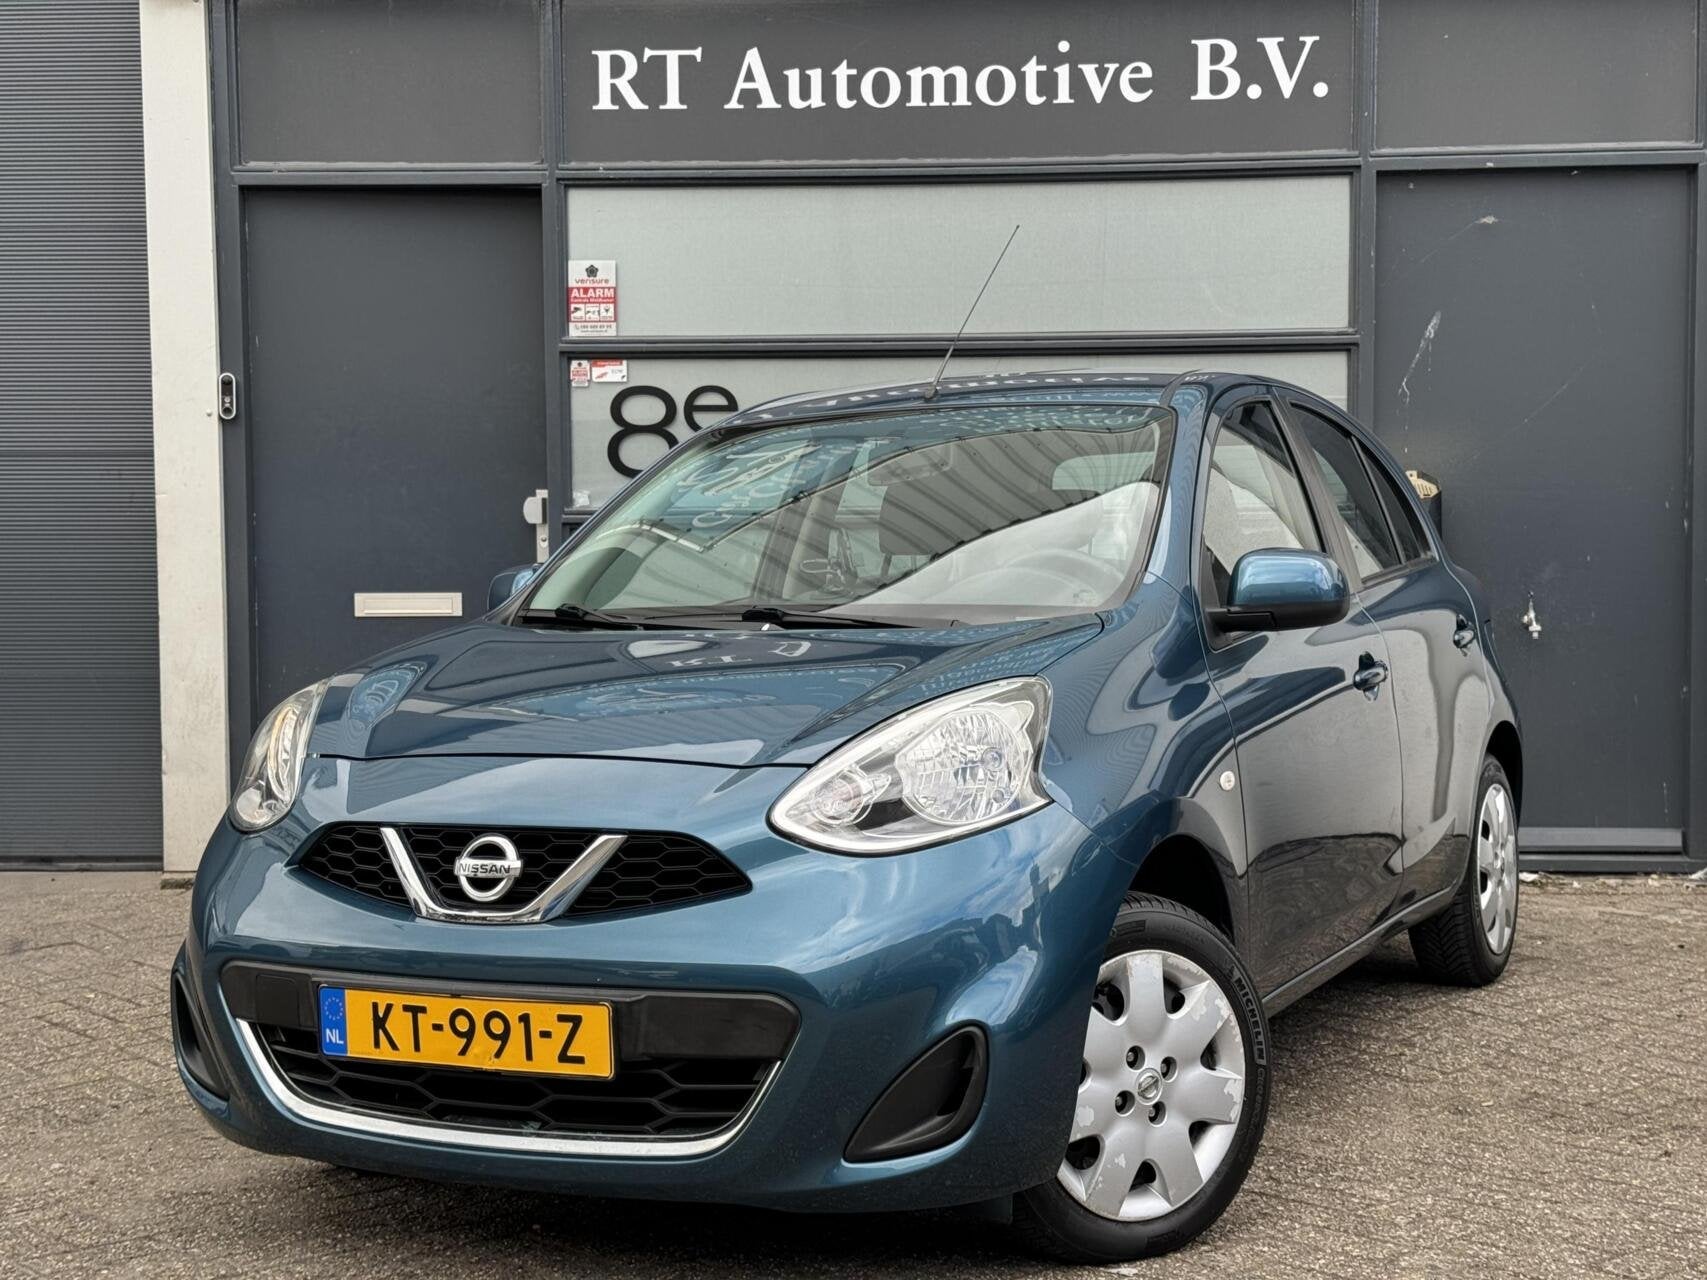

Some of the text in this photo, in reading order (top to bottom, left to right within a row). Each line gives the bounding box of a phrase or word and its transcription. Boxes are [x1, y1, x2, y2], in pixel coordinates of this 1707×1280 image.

[592, 35, 1328, 110] RT Automotive B.V.
[571, 288, 614, 298] ALARM
[459, 862, 511, 874] NISSAN
[326, 1028, 344, 1045] NL
[372, 1002, 586, 1065] KT-991-Z
[1234, 977, 1265, 1060] MICHELIN
